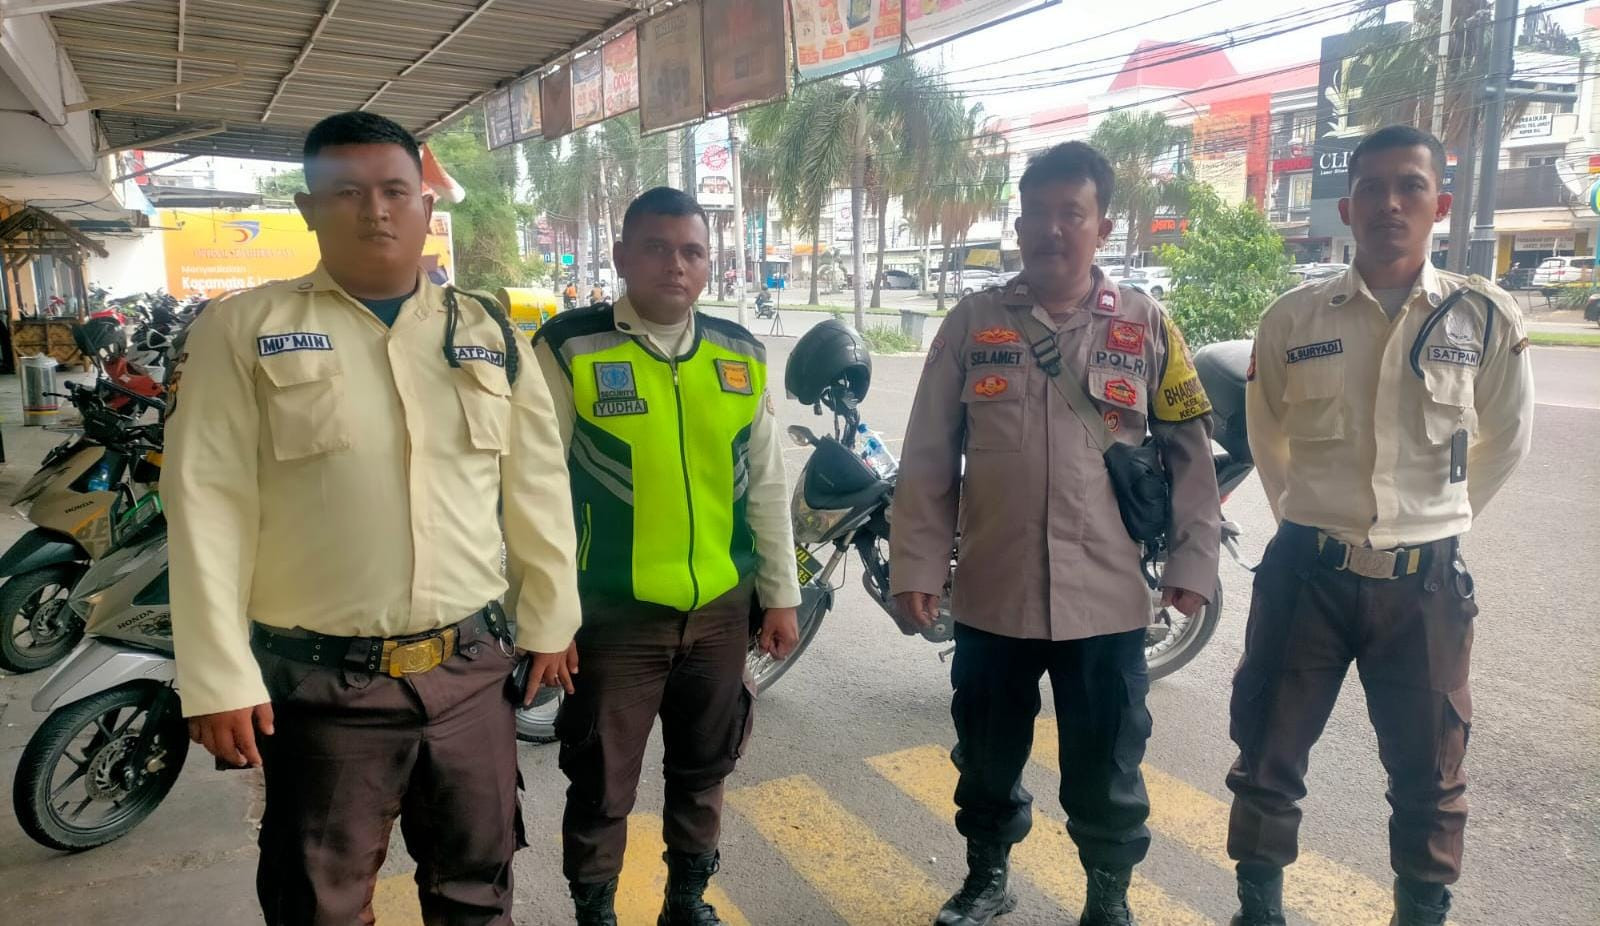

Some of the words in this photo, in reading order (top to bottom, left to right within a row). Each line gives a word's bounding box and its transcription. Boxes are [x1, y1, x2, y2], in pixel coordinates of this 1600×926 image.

[1319, 151, 1354, 169] CLI
[971, 350, 1023, 366] SELAMET
[1096, 351, 1148, 377] POLRI
[601, 390, 636, 399] SECURITY
[598, 401, 643, 414] YUDHA
[65, 500, 95, 514] HONDA
[117, 609, 156, 630] HONDA
